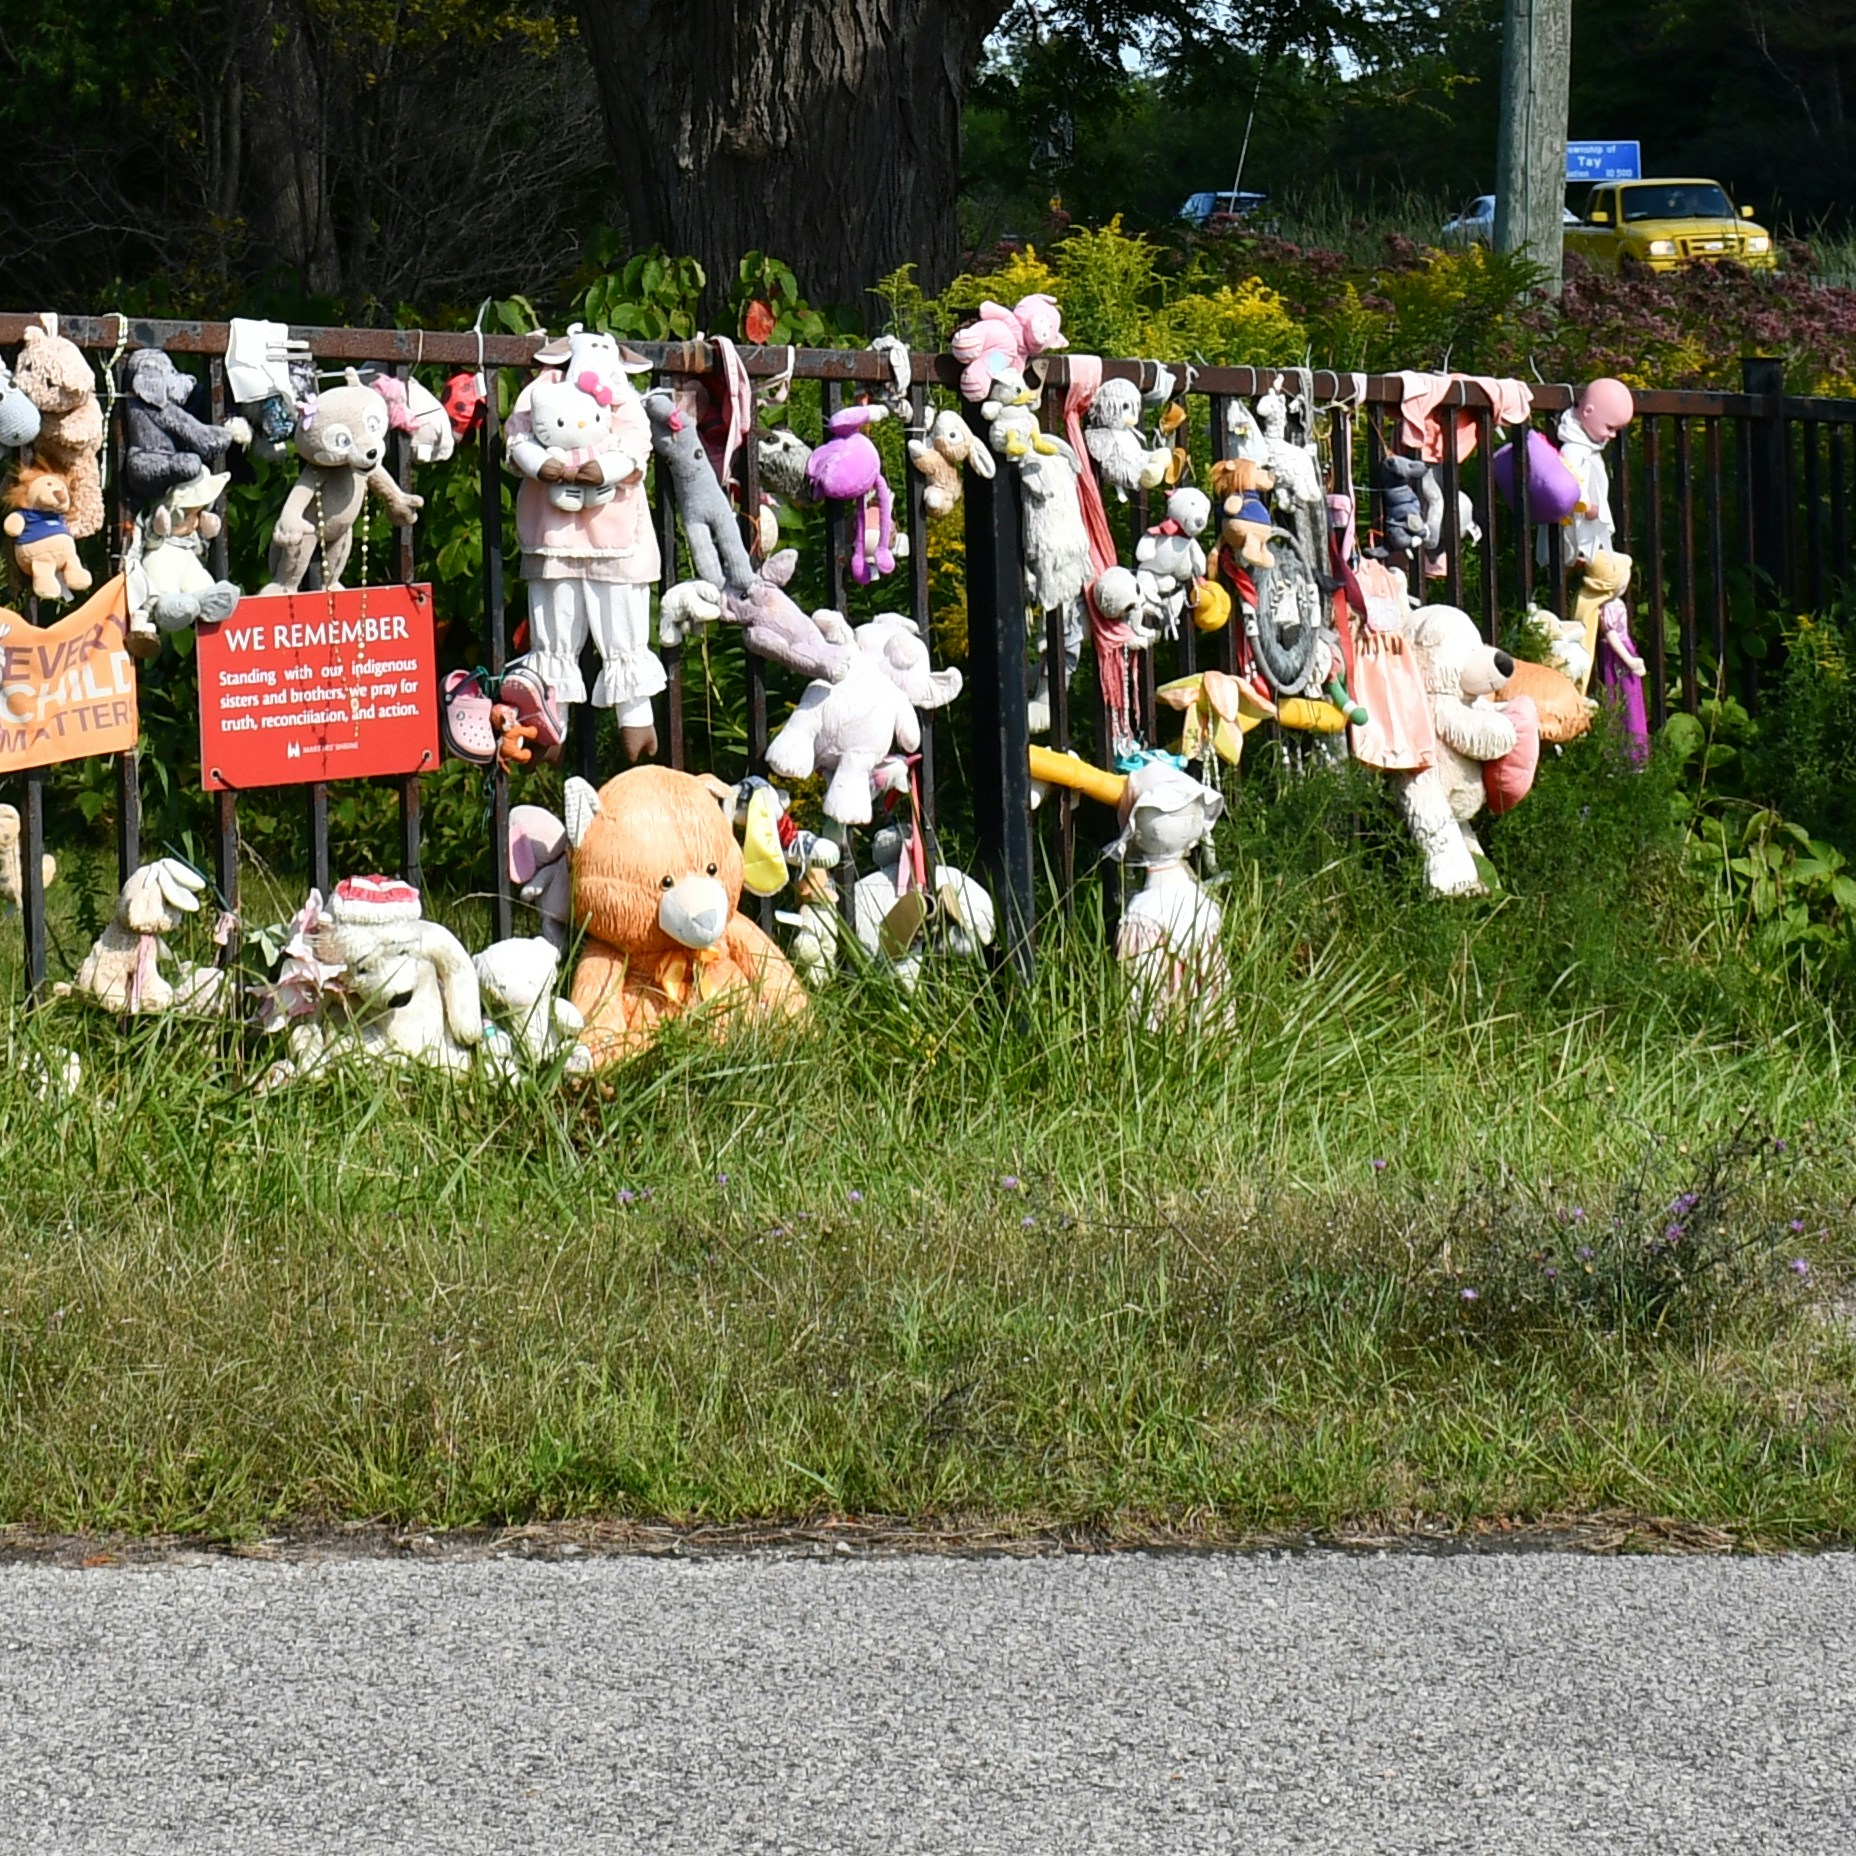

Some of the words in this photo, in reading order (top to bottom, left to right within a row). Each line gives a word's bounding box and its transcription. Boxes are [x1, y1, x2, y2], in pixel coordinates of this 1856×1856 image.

[1567, 146, 1604, 155] ownship
[1606, 145, 1616, 154] of
[1577, 155, 1602, 169] Tay
[224, 626, 266, 652] WE
[273, 615, 410, 650] REMEMBER
[218, 668, 277, 687] Standing
[284, 664, 313, 681] with
[321, 665, 344, 678] our
[351, 658, 418, 677] indigenous
[219, 693, 260, 710] sisters
[262, 689, 288, 705] and
[290, 685, 347, 704] brothers,
[349, 685, 368, 698] we
[370, 683, 398, 700] pray
[400, 678, 419, 694] for
[0, 700, 133, 754] MATTER
[220, 714, 259, 732] truth,
[261, 709, 350, 730] reconciliation,
[351, 704, 376, 720] and
[378, 702, 420, 719] action.
